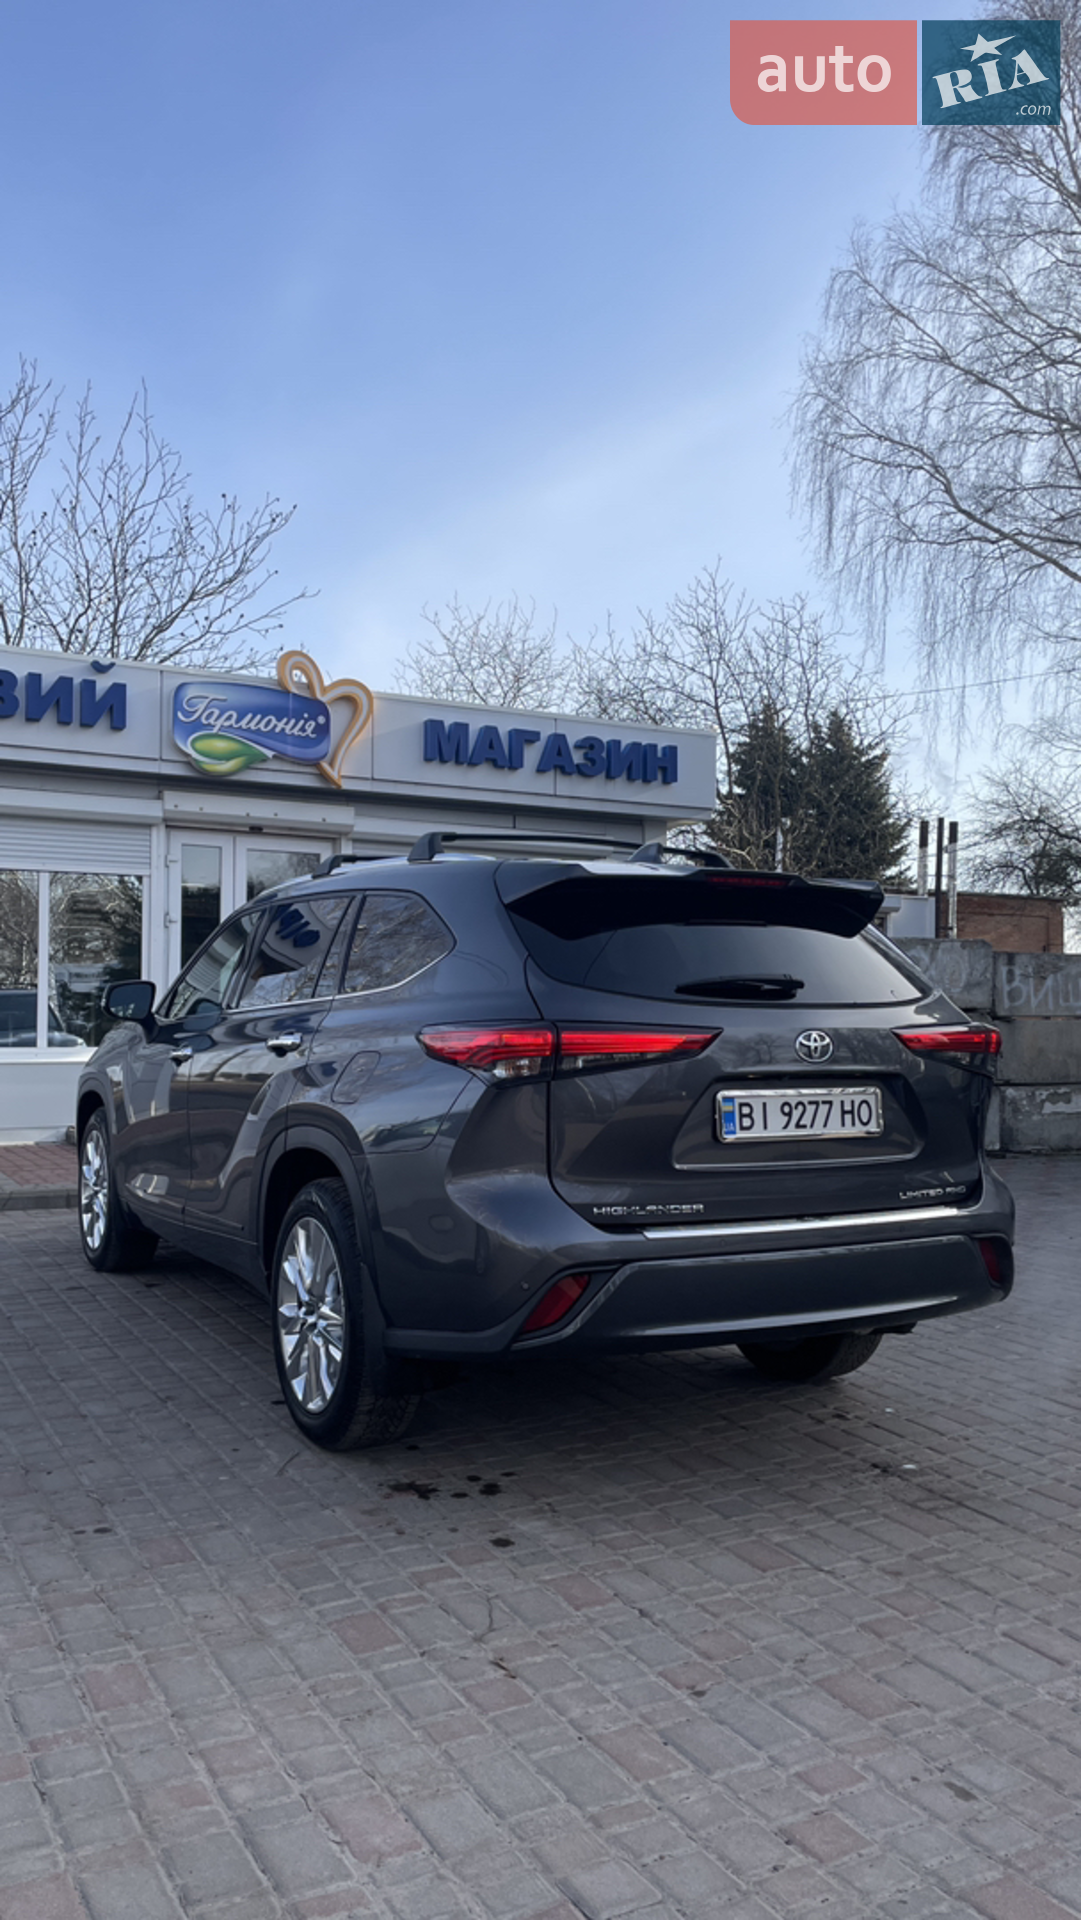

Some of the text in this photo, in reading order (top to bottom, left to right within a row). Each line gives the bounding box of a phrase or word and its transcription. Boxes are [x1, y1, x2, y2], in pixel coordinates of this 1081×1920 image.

[177, 694, 318, 738] Гармонія
[423, 719, 678, 784] МАГАЗИН
[738, 1099, 873, 1131] BI 9277 HO
[899, 1187, 944, 1199] LIMITED
[593, 1203, 705, 1216] HIGHLANDER
